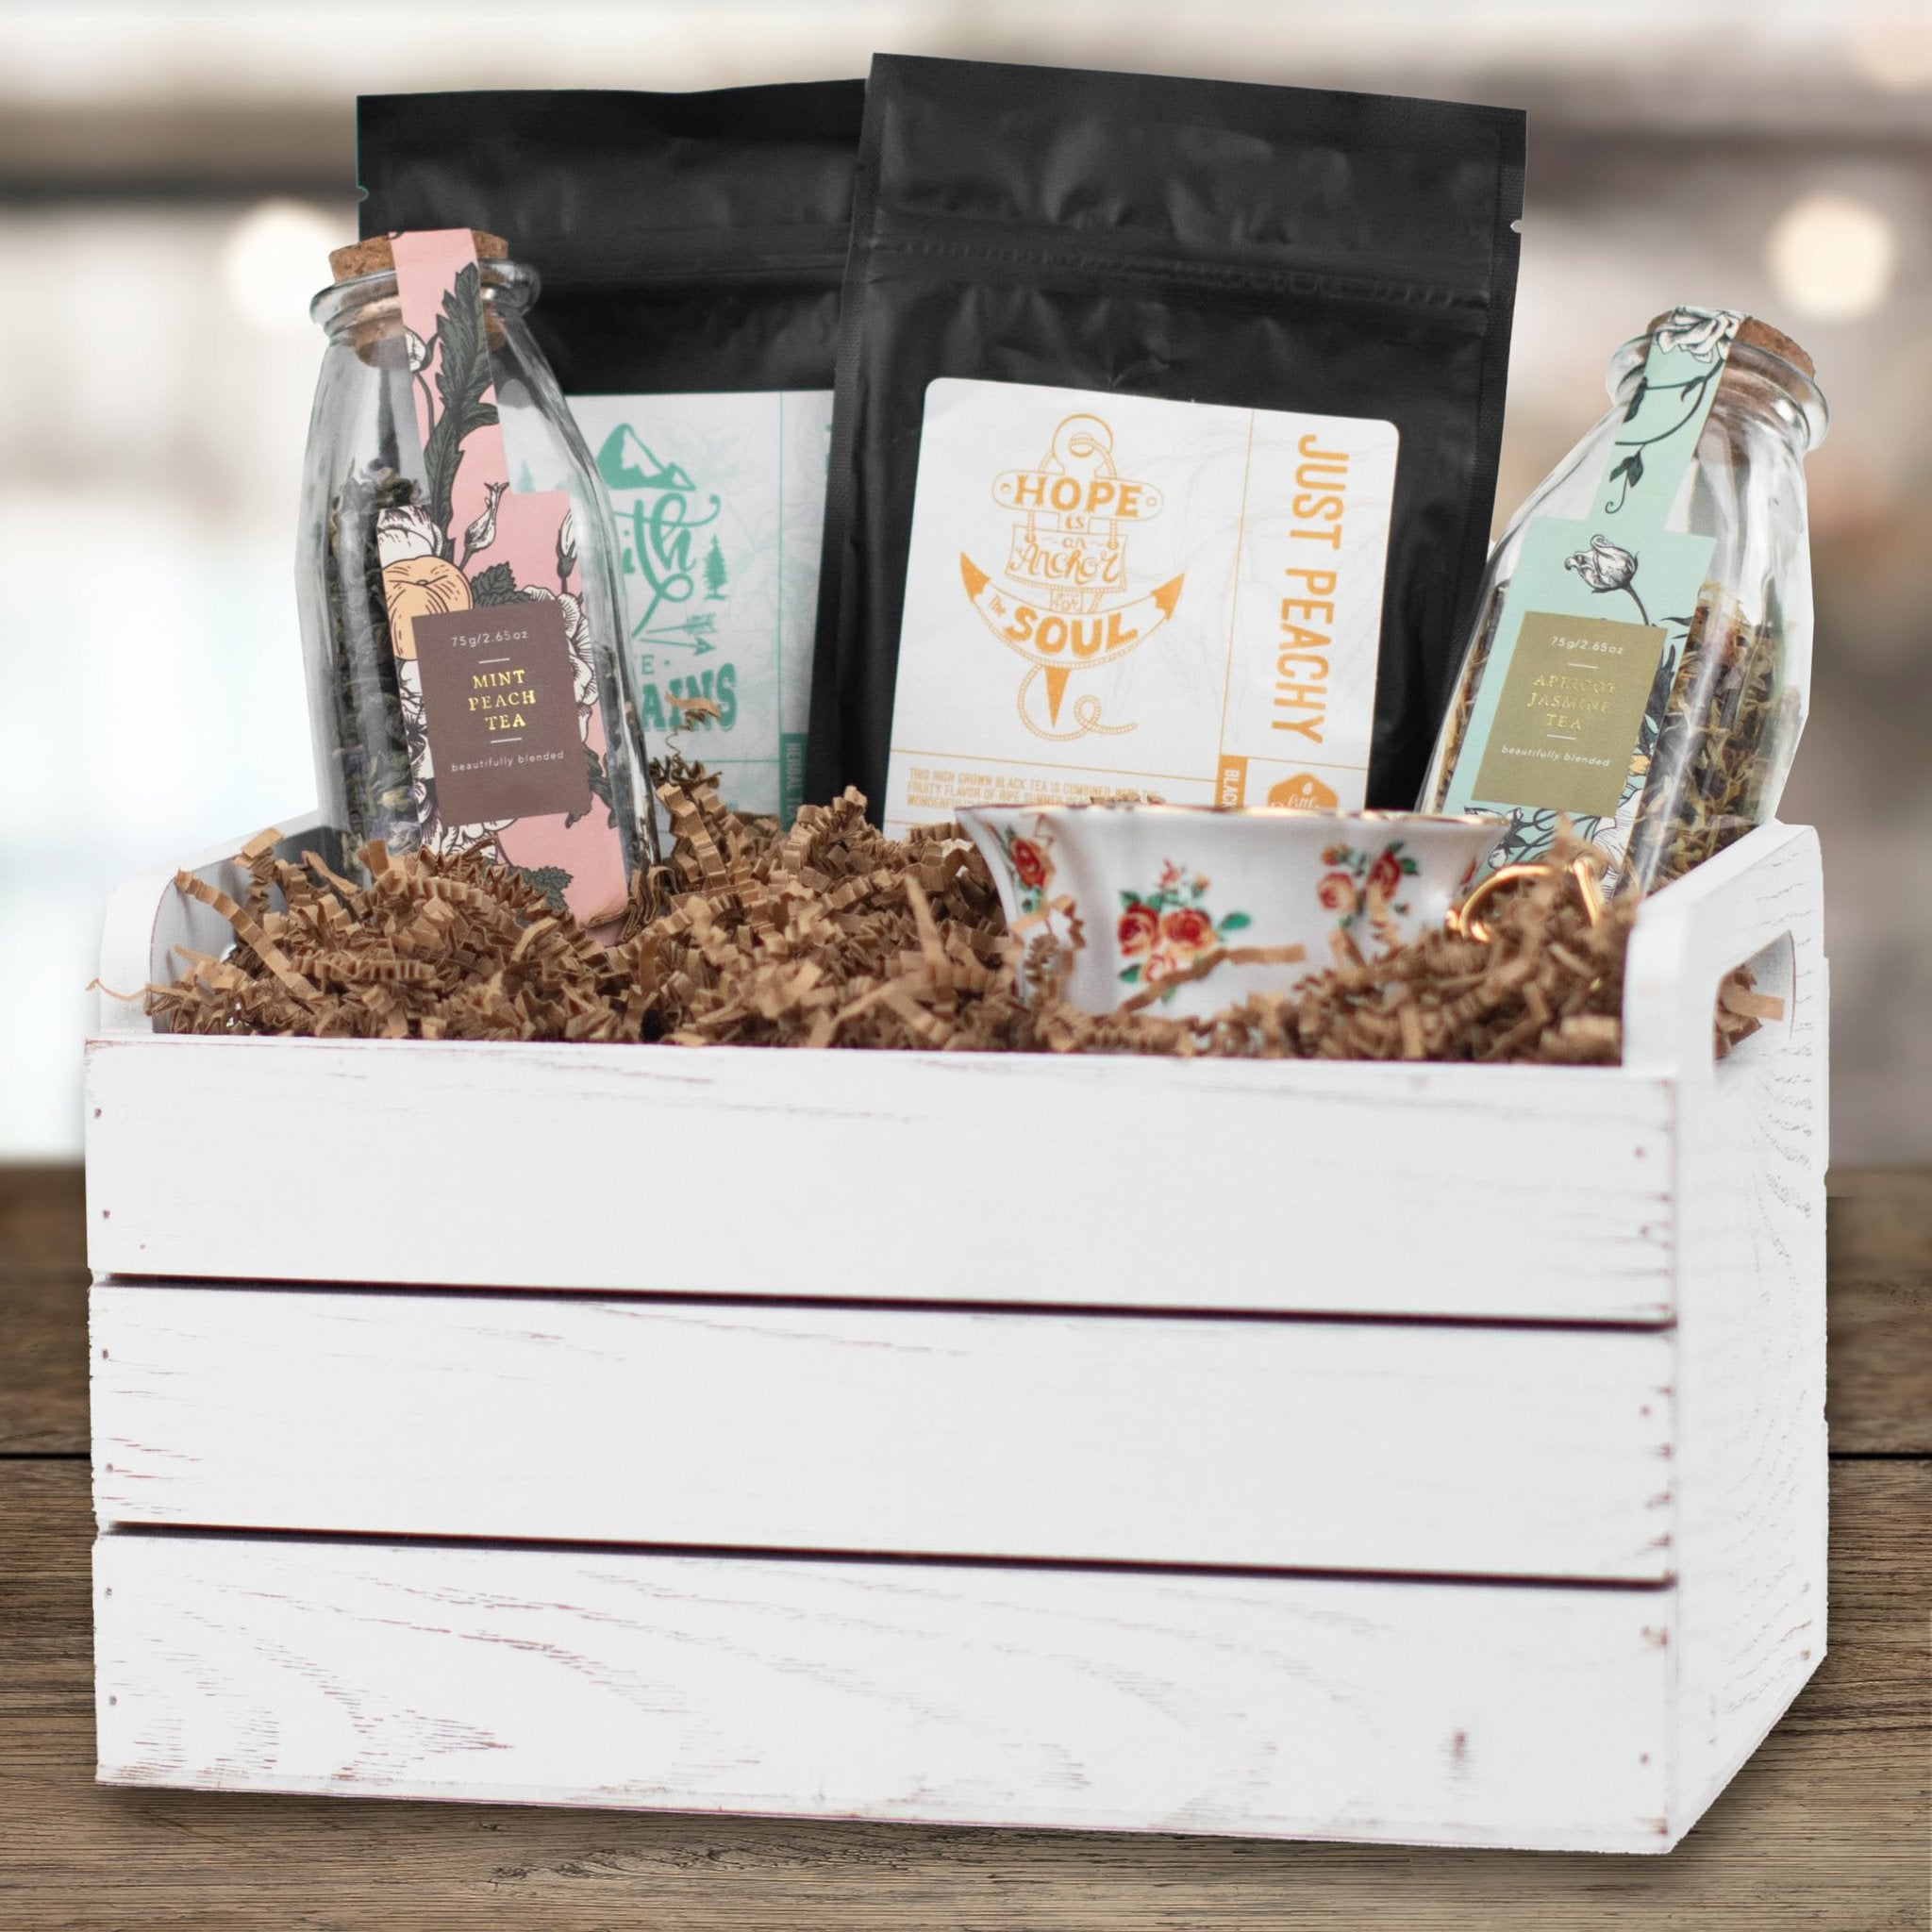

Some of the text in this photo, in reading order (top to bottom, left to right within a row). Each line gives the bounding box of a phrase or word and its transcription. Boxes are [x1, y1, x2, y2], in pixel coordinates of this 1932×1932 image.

[1013, 474, 1143, 518] HOPE
[1065, 515, 1084, 529] is
[1062, 537, 1087, 549] an
[1008, 542, 1121, 585] Anchor
[1271, 433, 1350, 744] JUST PEACHY
[1054, 592, 1078, 611] for
[451, 630, 528, 648] 75g/2.65oz
[1004, 606, 1139, 658] SOUL
[1550, 637, 1624, 655] 75g/2.65oz
[473, 670, 525, 689] MINT
[1533, 675, 1617, 695] APRICOT
[468, 690, 536, 711] PEACH
[1526, 692, 1611, 712] JASMINE
[485, 713, 526, 730] TEA
[1546, 713, 1582, 730] TEA
[451, 750, 564, 773] beautifully blended
[1501, 745, 1610, 767] beautifully blended
[1030, 779, 1047, 791] TEA
[1222, 769, 1241, 808] BLACK
